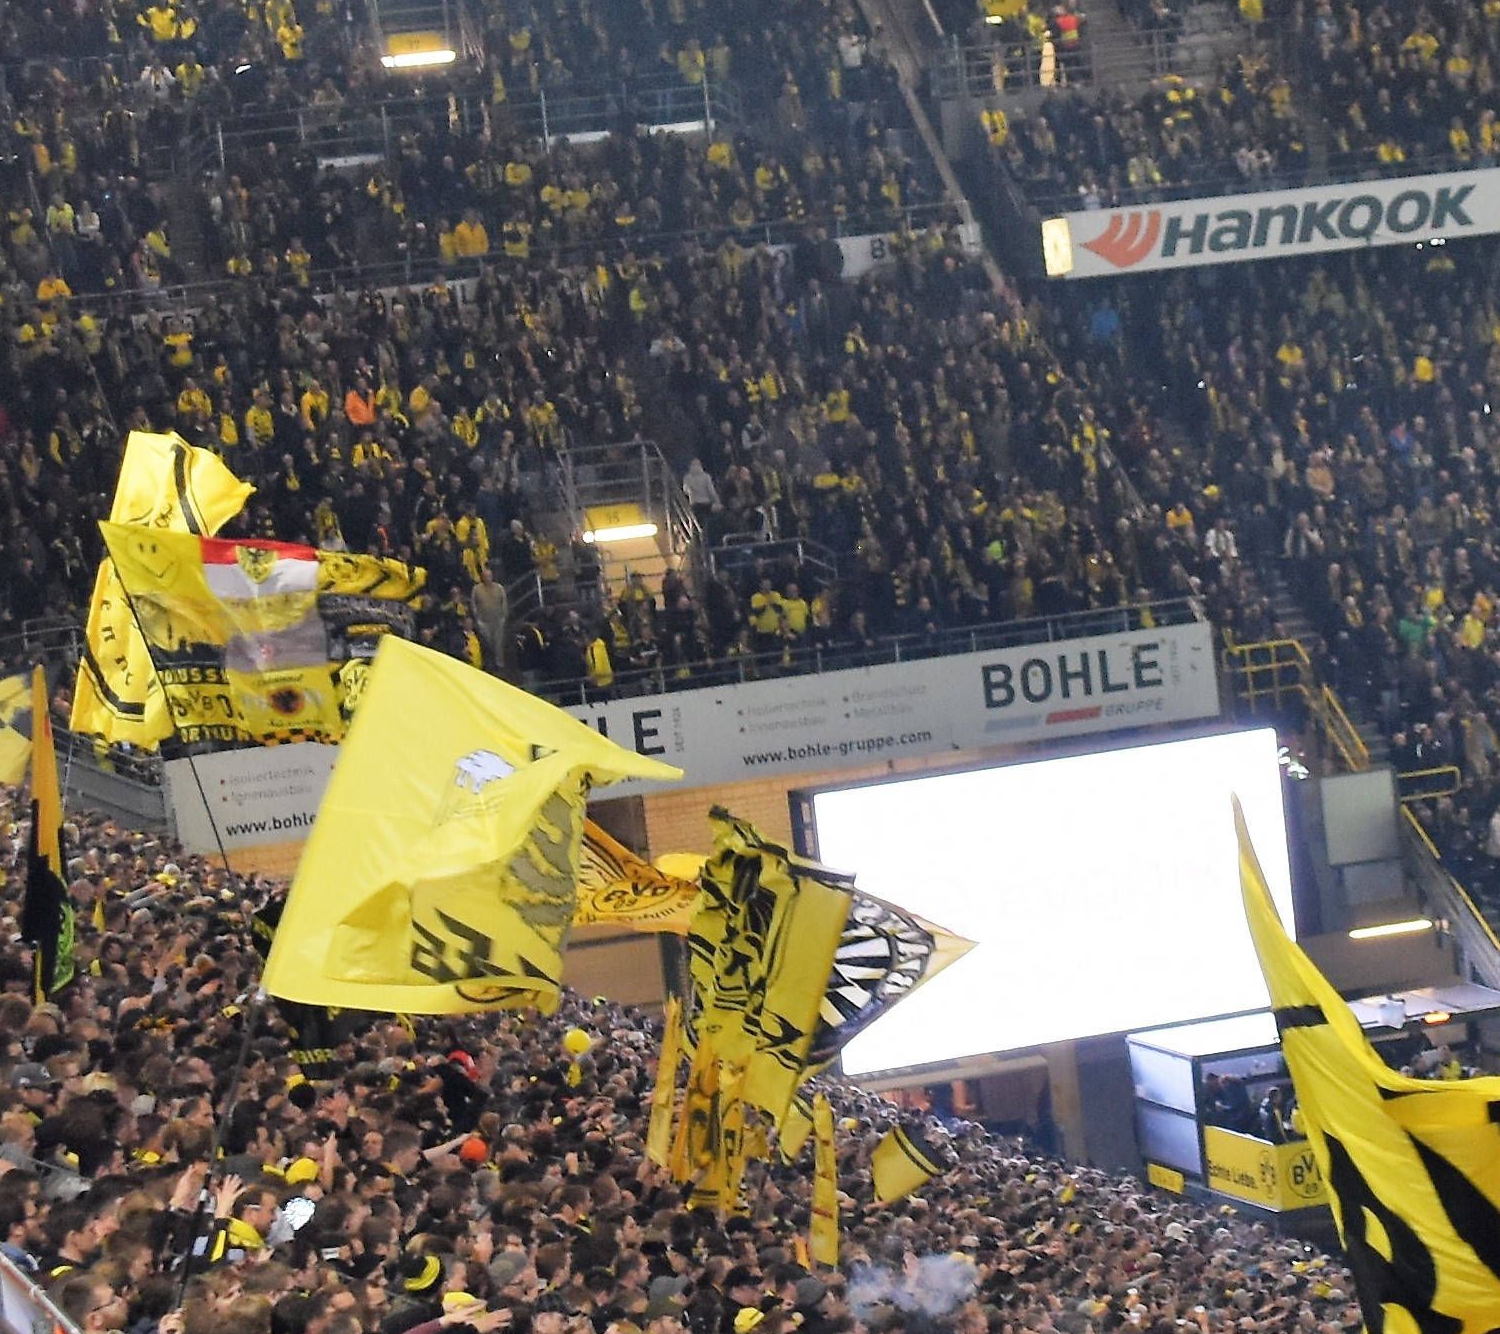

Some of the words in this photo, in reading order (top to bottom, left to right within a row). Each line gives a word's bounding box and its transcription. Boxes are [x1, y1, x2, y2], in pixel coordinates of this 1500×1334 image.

[980, 643, 1164, 709] BOHLE
[1104, 696, 1164, 718] GRUPPE
[743, 729, 932, 767] www.bohle-gruppe.com
[226, 812, 316, 837] www.bohle
